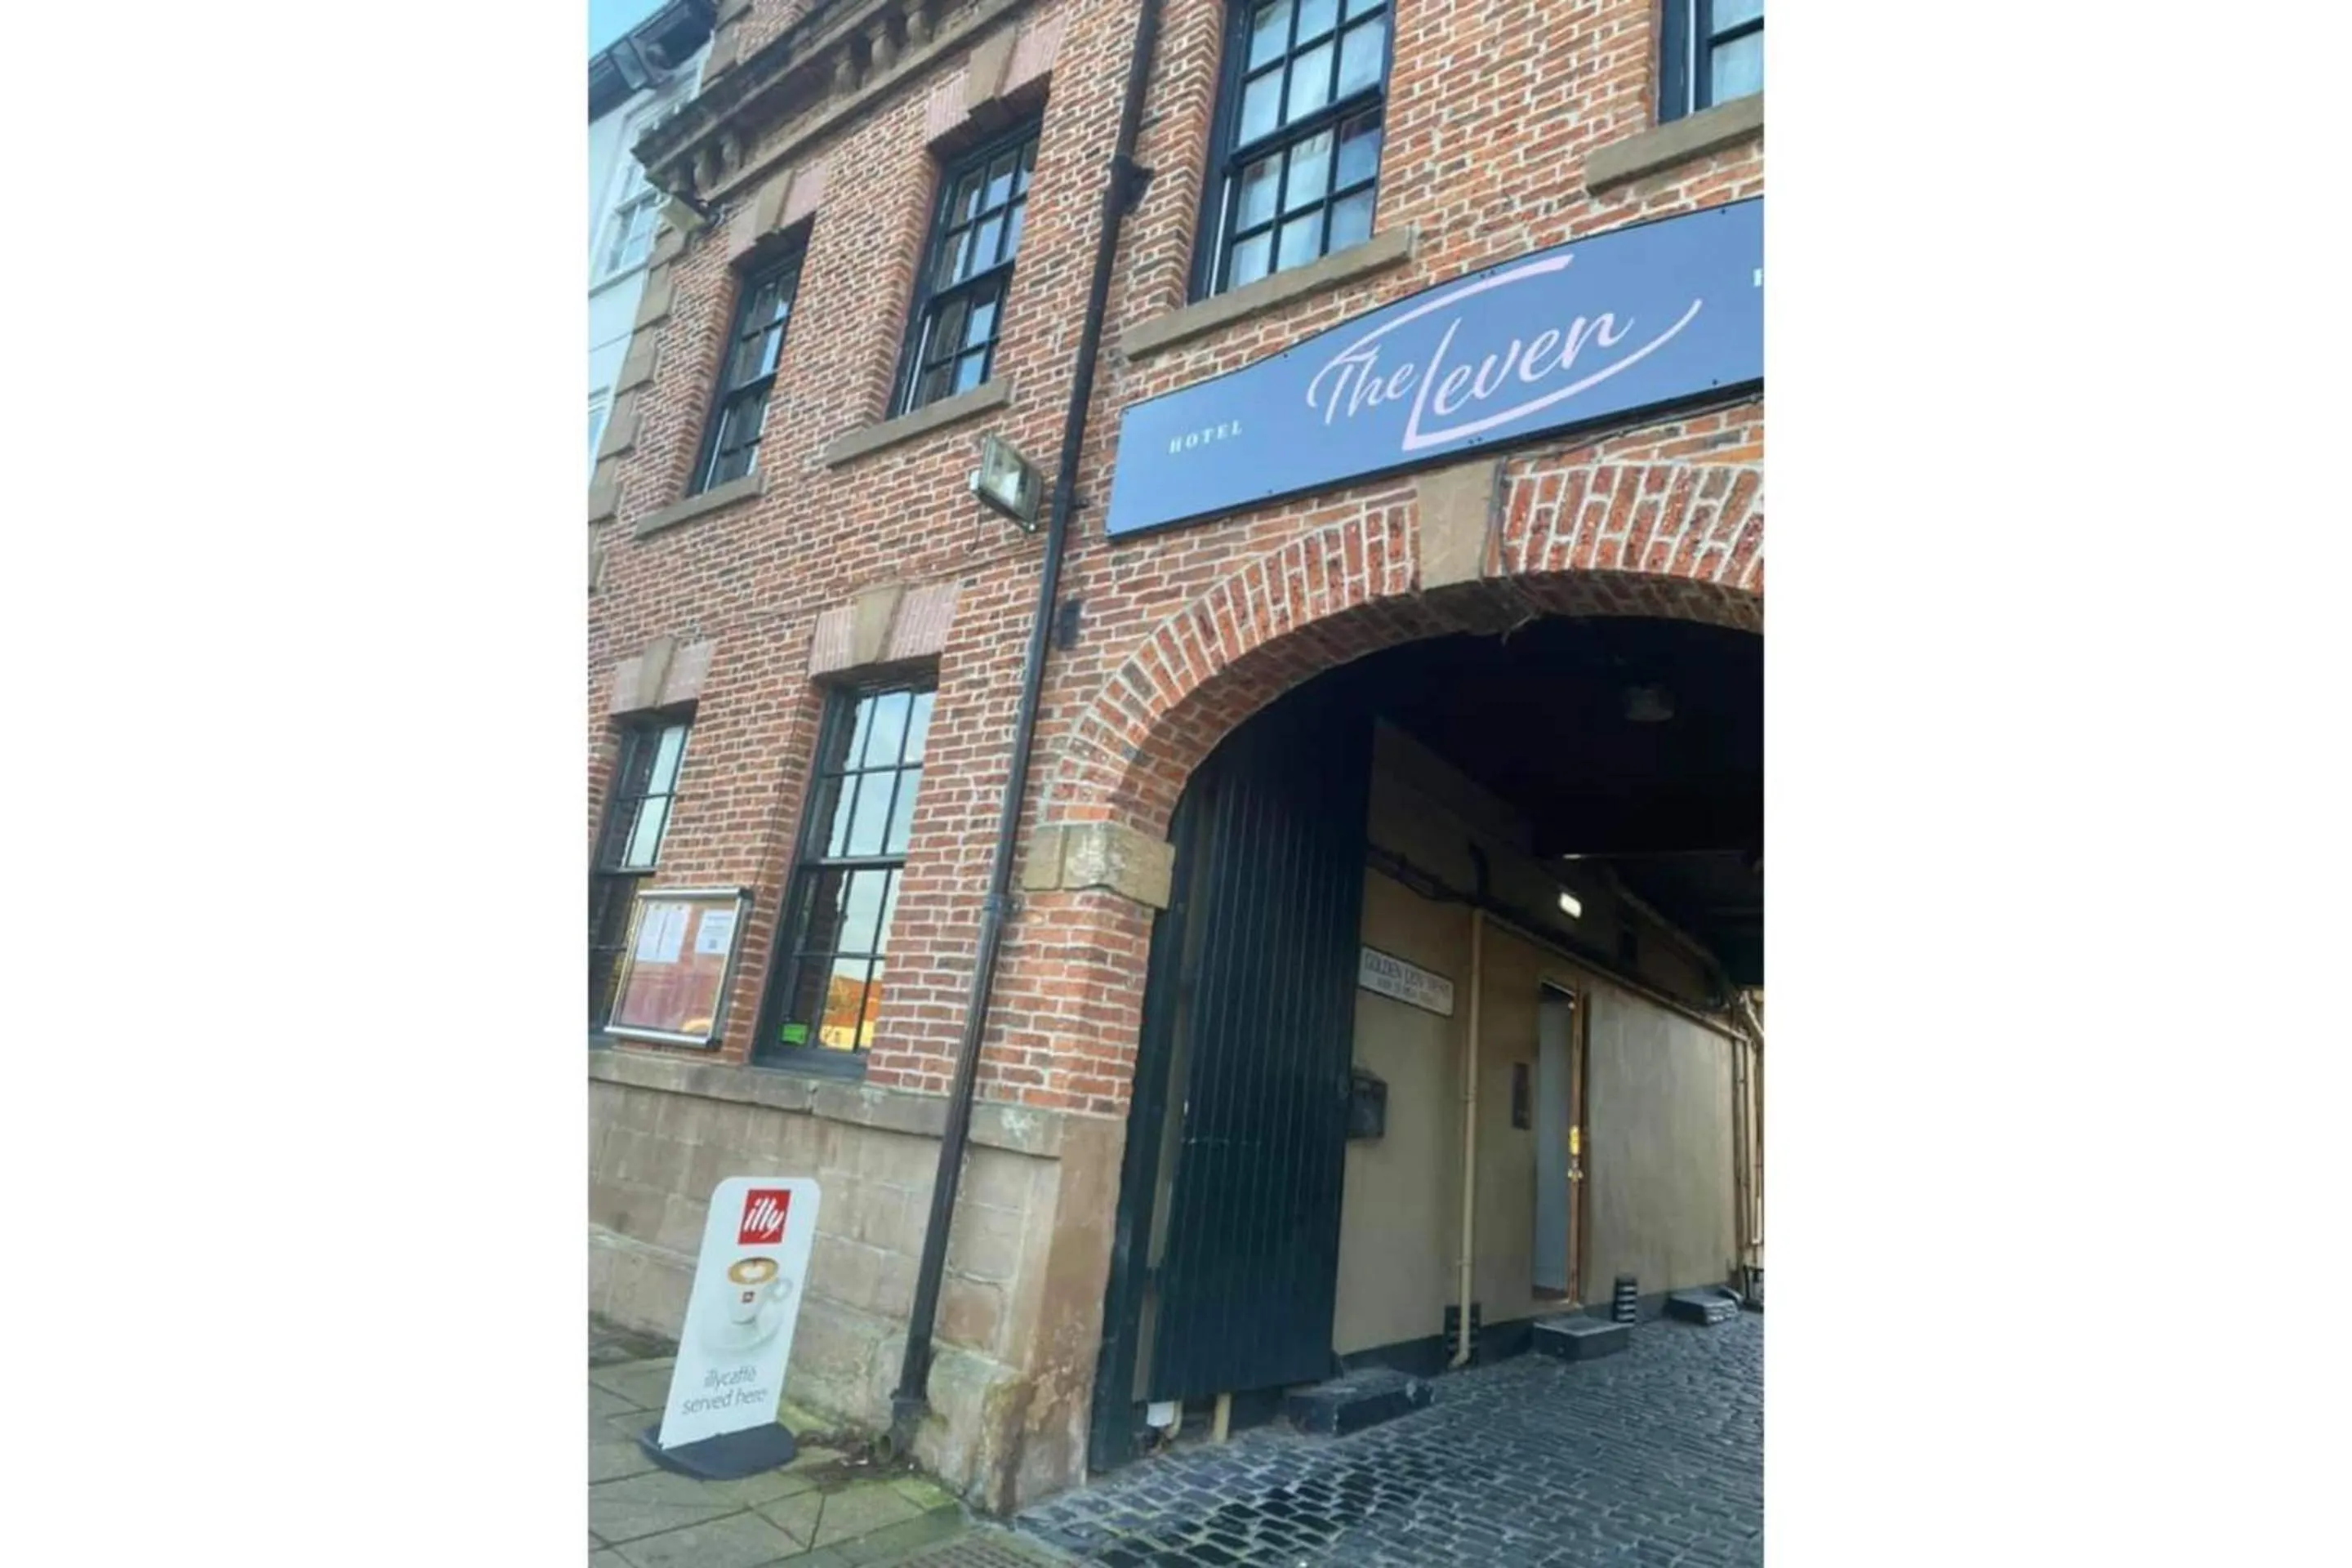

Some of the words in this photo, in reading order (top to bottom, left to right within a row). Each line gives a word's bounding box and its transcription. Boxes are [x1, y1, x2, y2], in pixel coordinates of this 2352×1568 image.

[1401, 299, 1704, 452] Leven
[1168, 419, 1243, 455] HOTEL
[743, 1196, 785, 1241] illy
[682, 1388, 734, 1415] served
[735, 1388, 768, 1406] here
